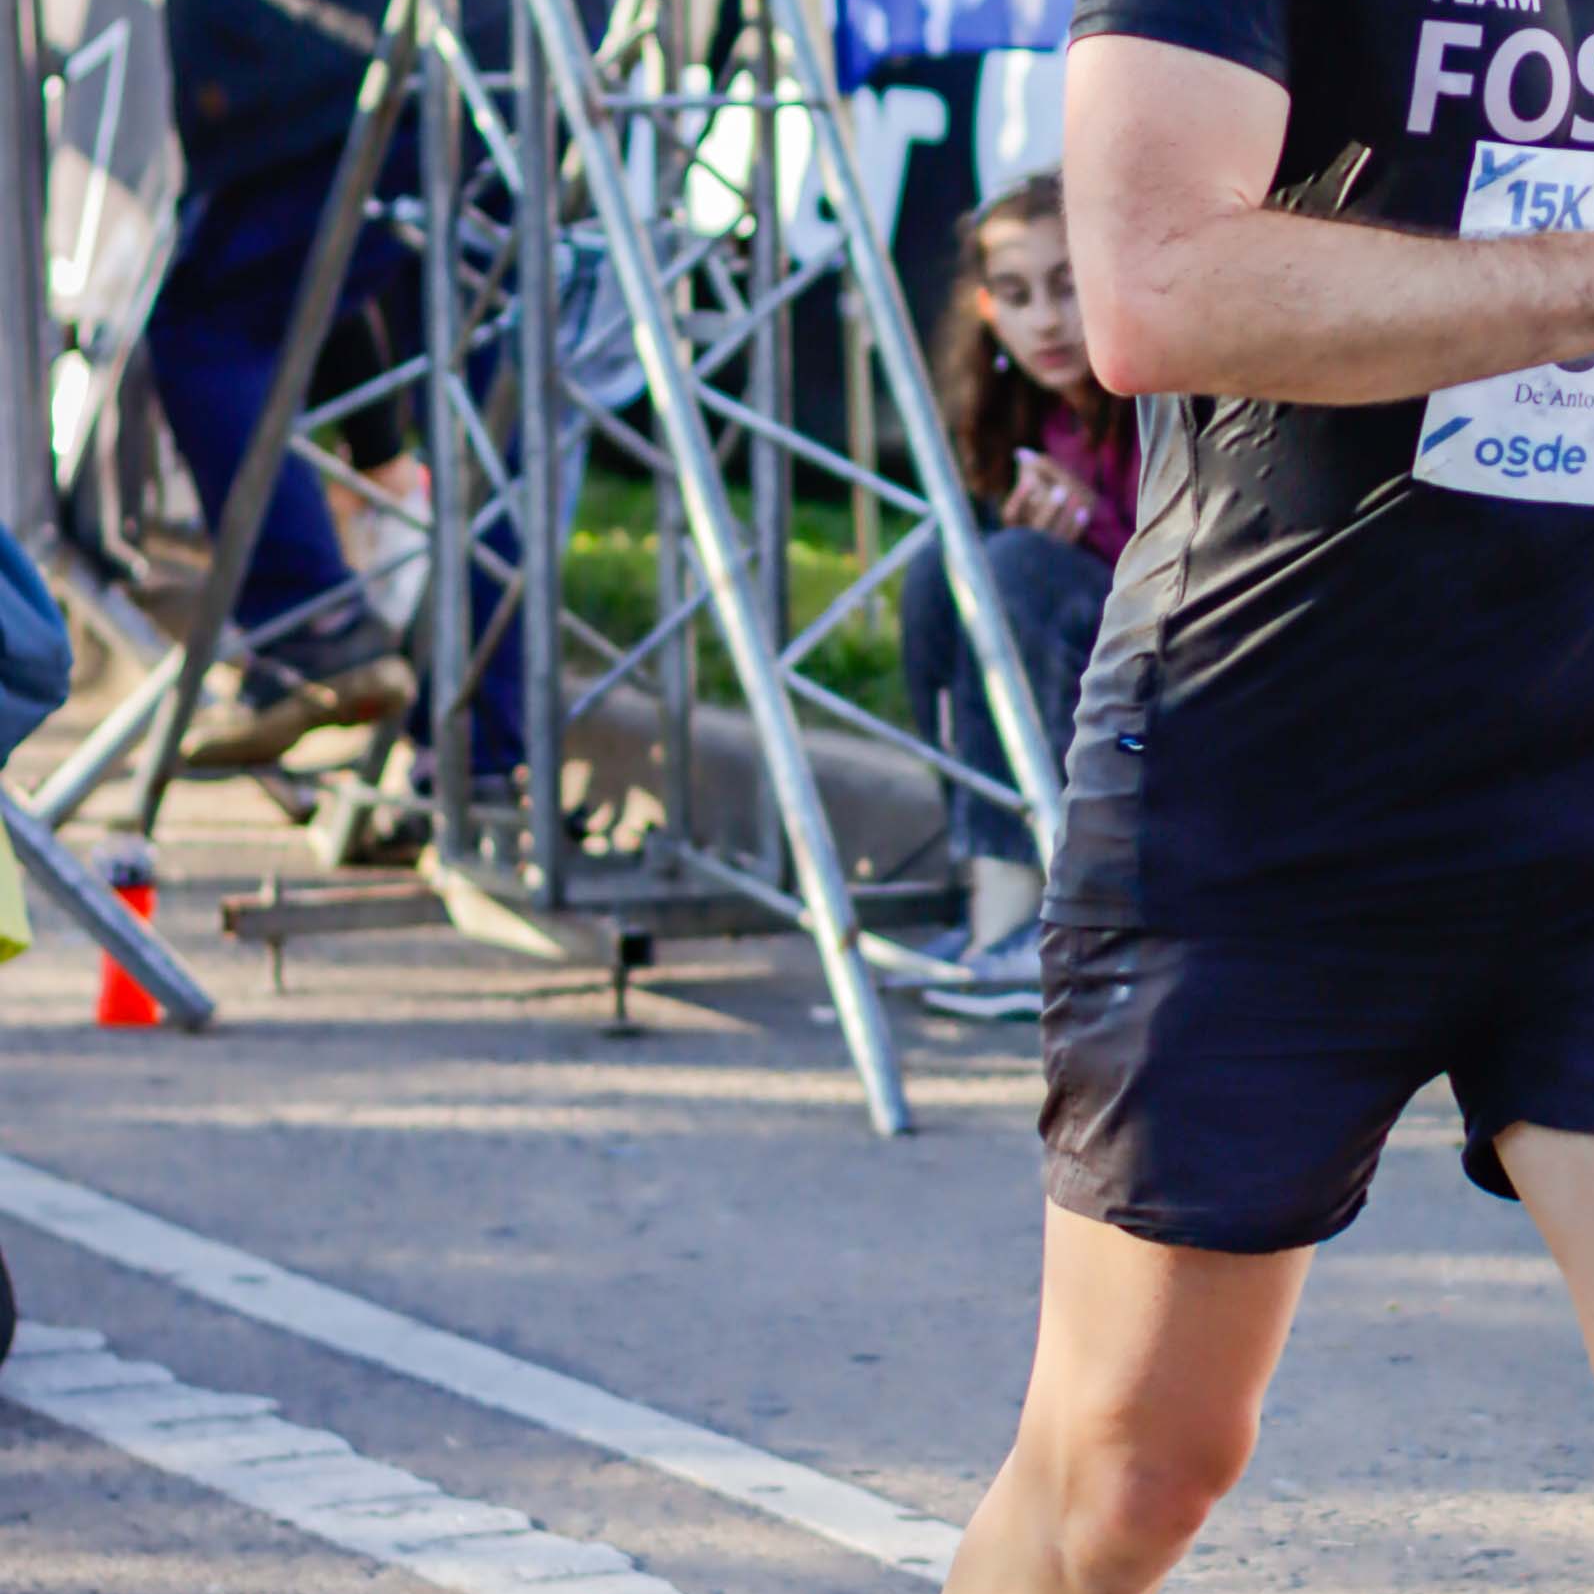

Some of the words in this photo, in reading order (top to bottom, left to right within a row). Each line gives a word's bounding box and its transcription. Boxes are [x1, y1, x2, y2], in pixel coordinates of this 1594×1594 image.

[1507, 179, 1593, 230] 15K
[1514, 382, 1544, 405] De
[1474, 434, 1587, 478] osde
